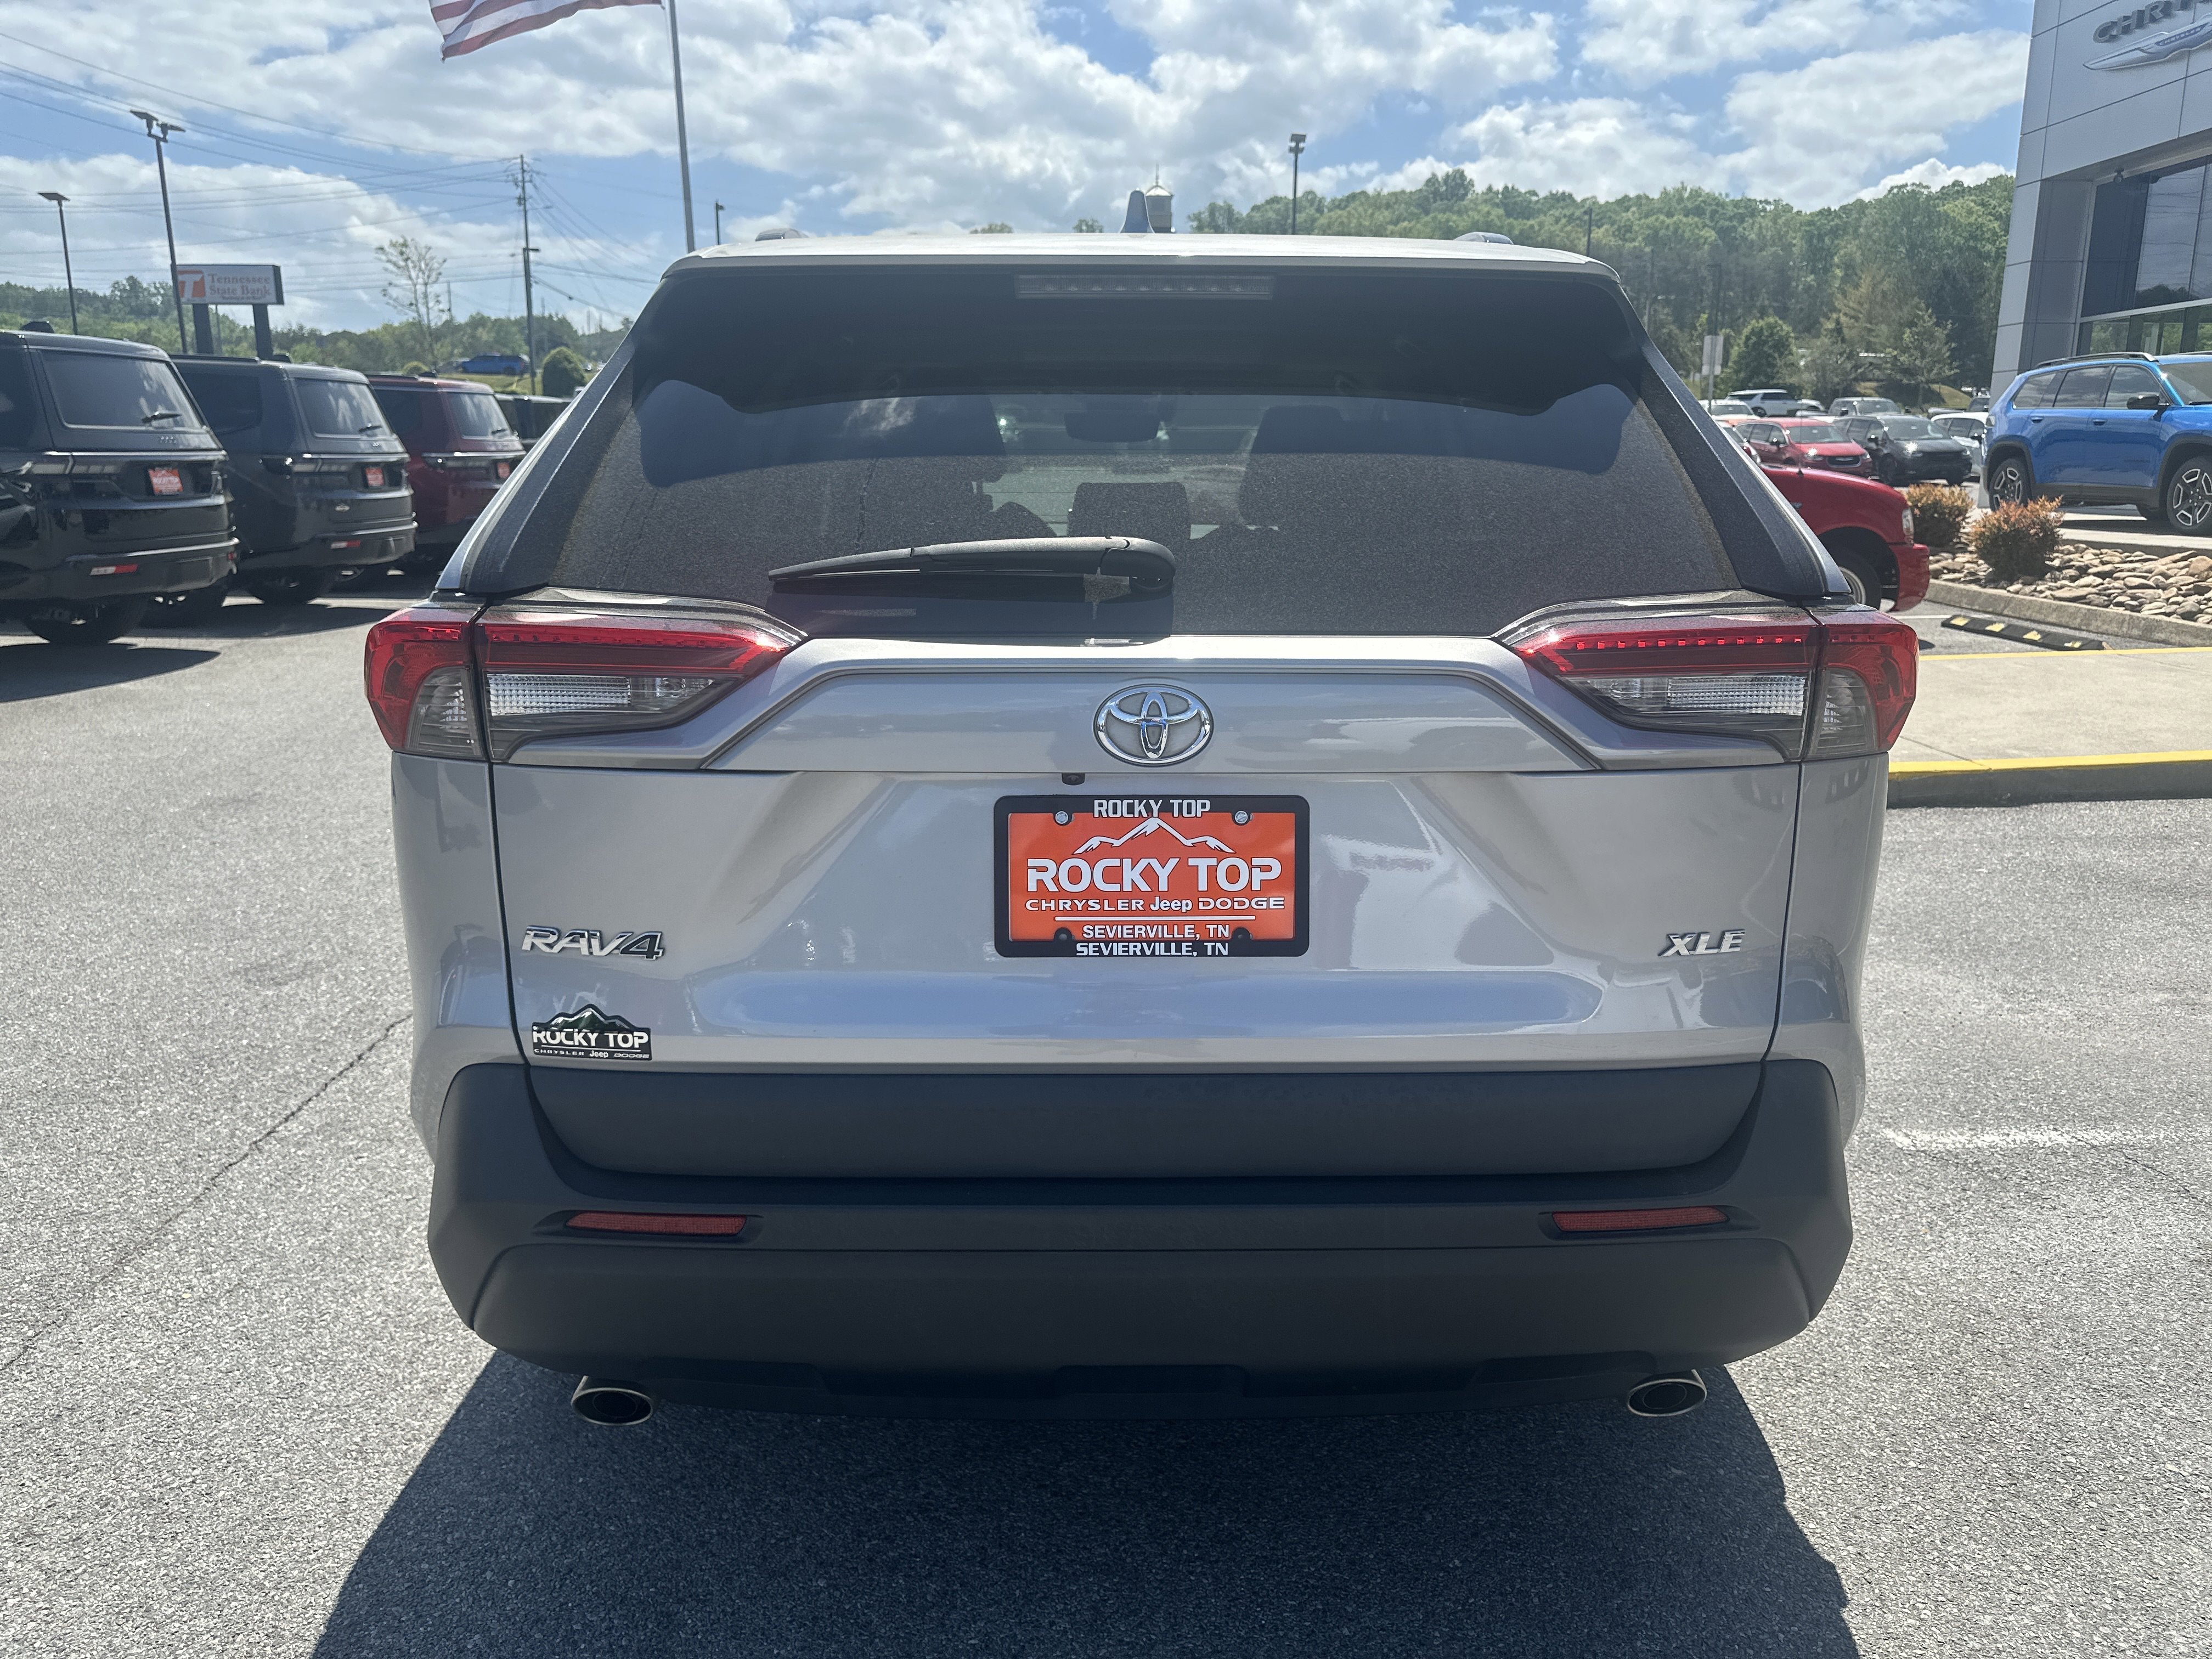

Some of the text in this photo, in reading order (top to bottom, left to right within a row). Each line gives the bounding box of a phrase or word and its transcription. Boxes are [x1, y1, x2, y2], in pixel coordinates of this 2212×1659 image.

[208, 274, 271, 284] Tennessee
[209, 285, 271, 296] State Bank
[1094, 799, 1210, 817] ROCKY TOP
[1027, 857, 1282, 893] ROCKY TOP
[1025, 896, 1285, 913] CHRYSLER Jeep DODGE
[1082, 924, 1230, 941] SEVIERVILLE, TN
[522, 925, 663, 961] RAV4
[1076, 942, 1228, 957] SEVIERVILLE, TN
[1658, 929, 1746, 957] XLE
[532, 1026, 649, 1048] ROCKY TOP
[589, 1049, 609, 1058] Jeep
